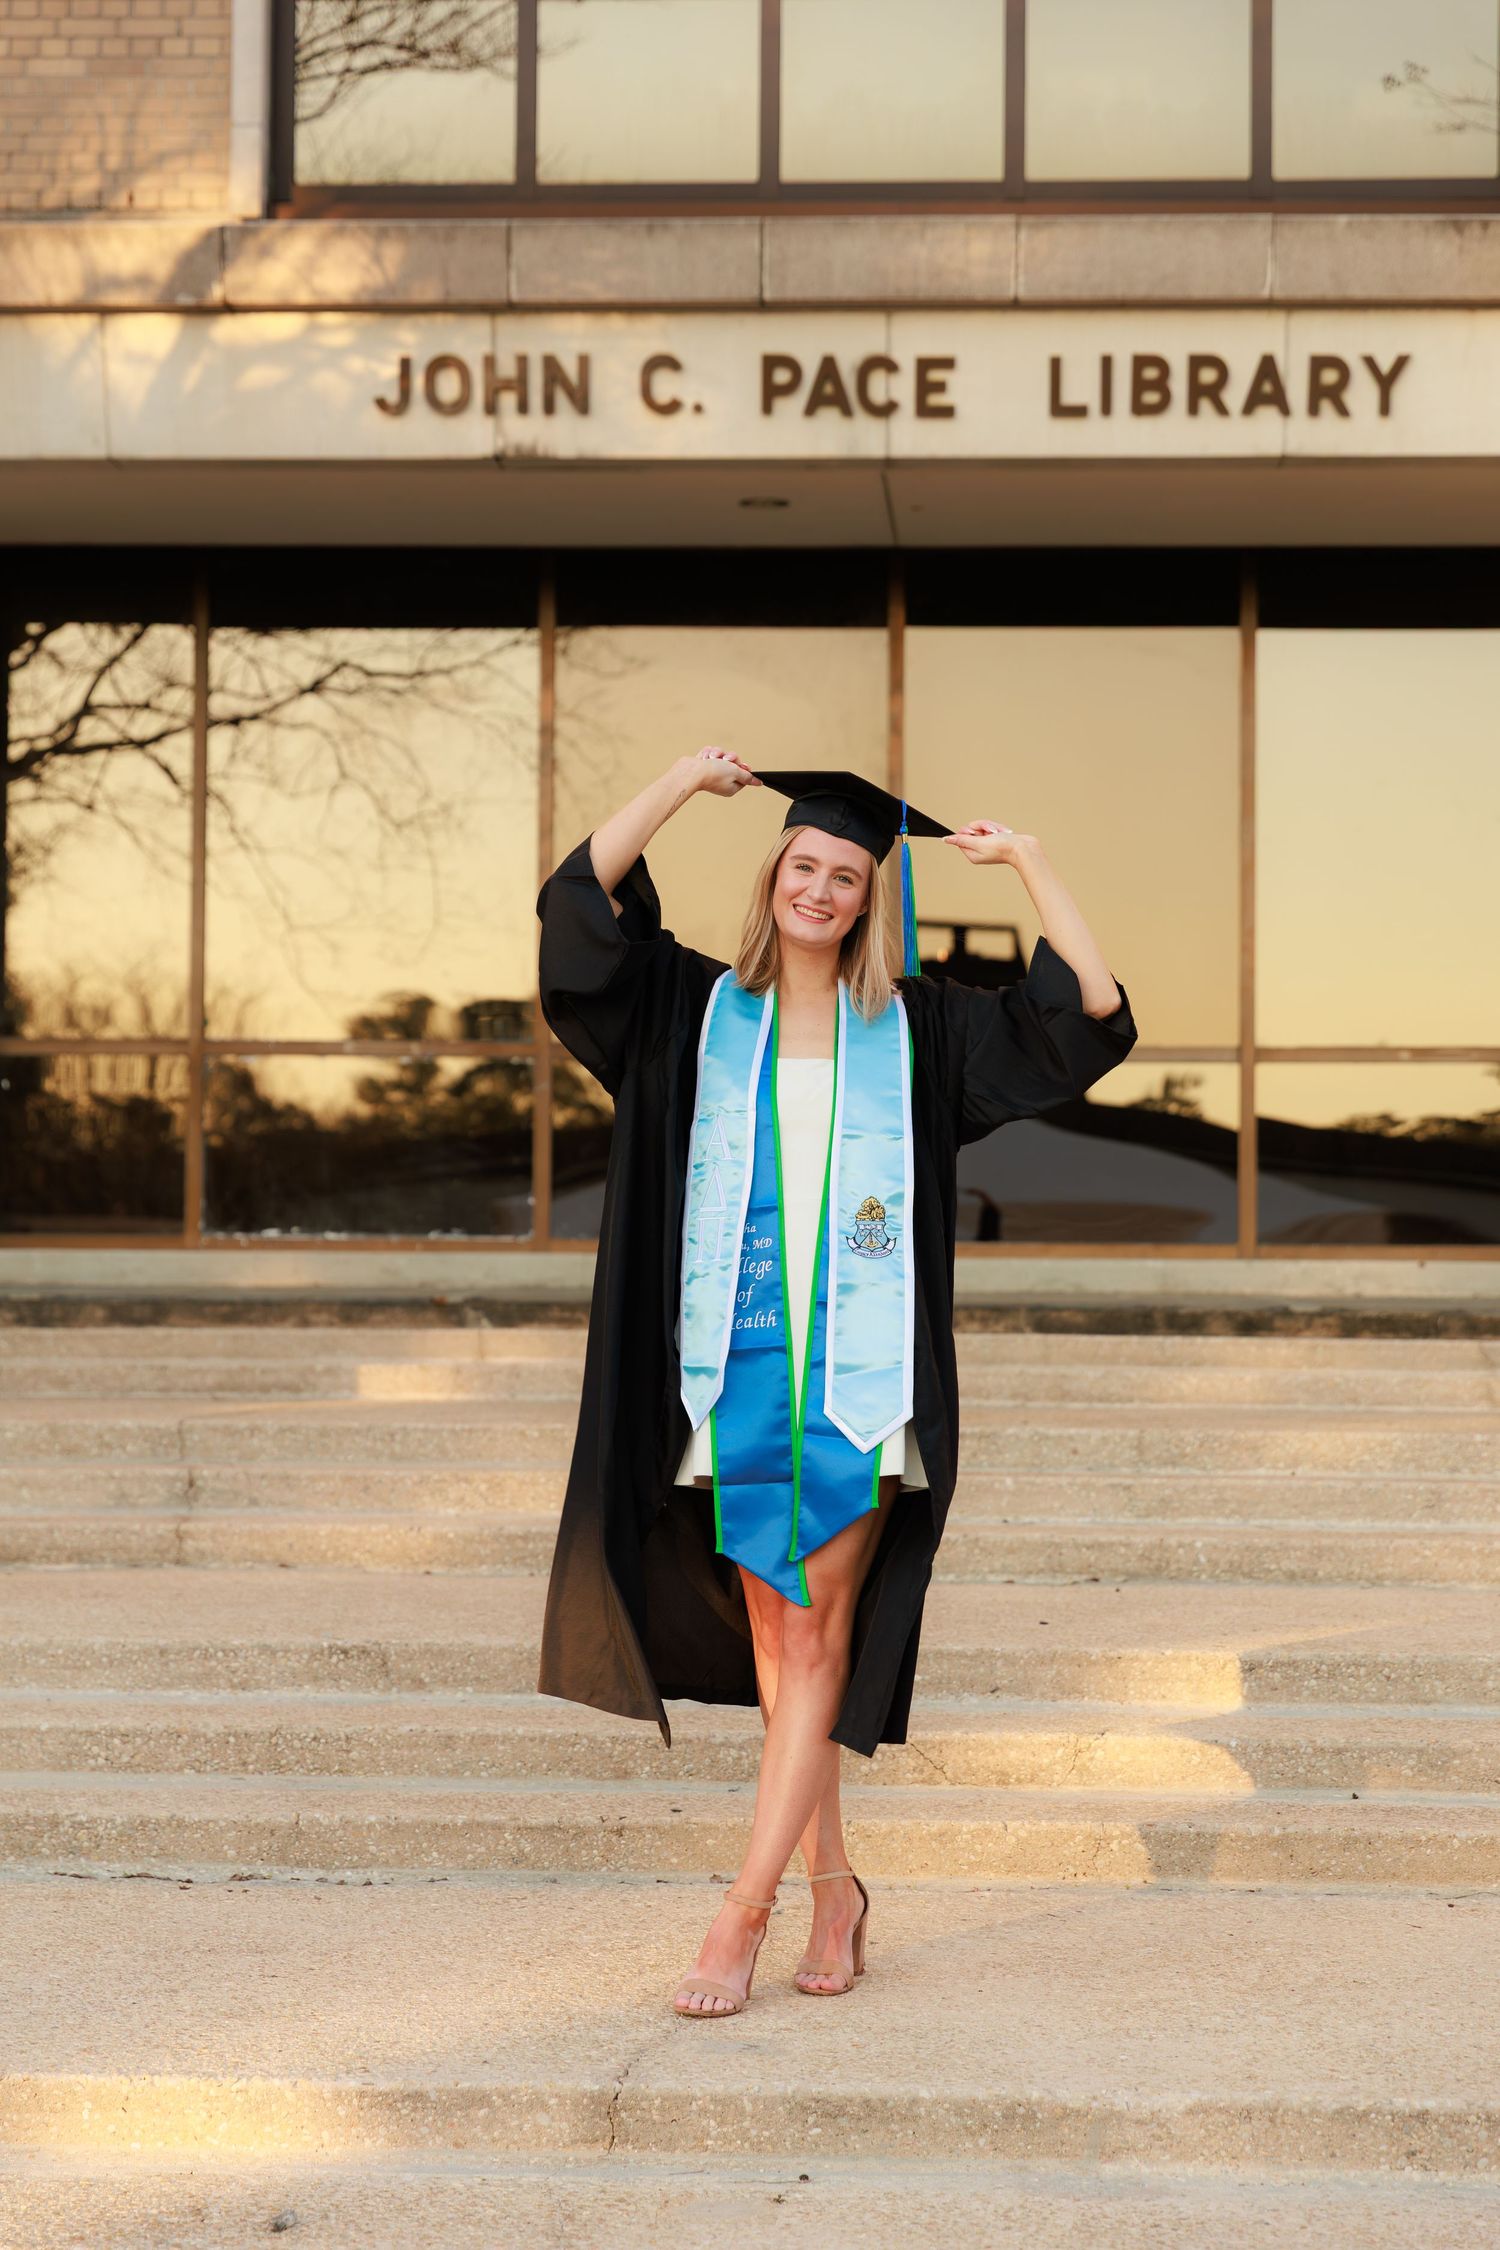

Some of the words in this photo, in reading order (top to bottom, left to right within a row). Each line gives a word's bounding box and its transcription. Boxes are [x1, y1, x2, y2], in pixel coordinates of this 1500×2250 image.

[376, 353, 591, 417] JOHN
[640, 353, 706, 417] C.
[762, 354, 956, 417] PACE
[1049, 353, 1410, 418] LIBRARY
[752, 1237, 772, 1250] MD
[737, 1283, 756, 1308] of
